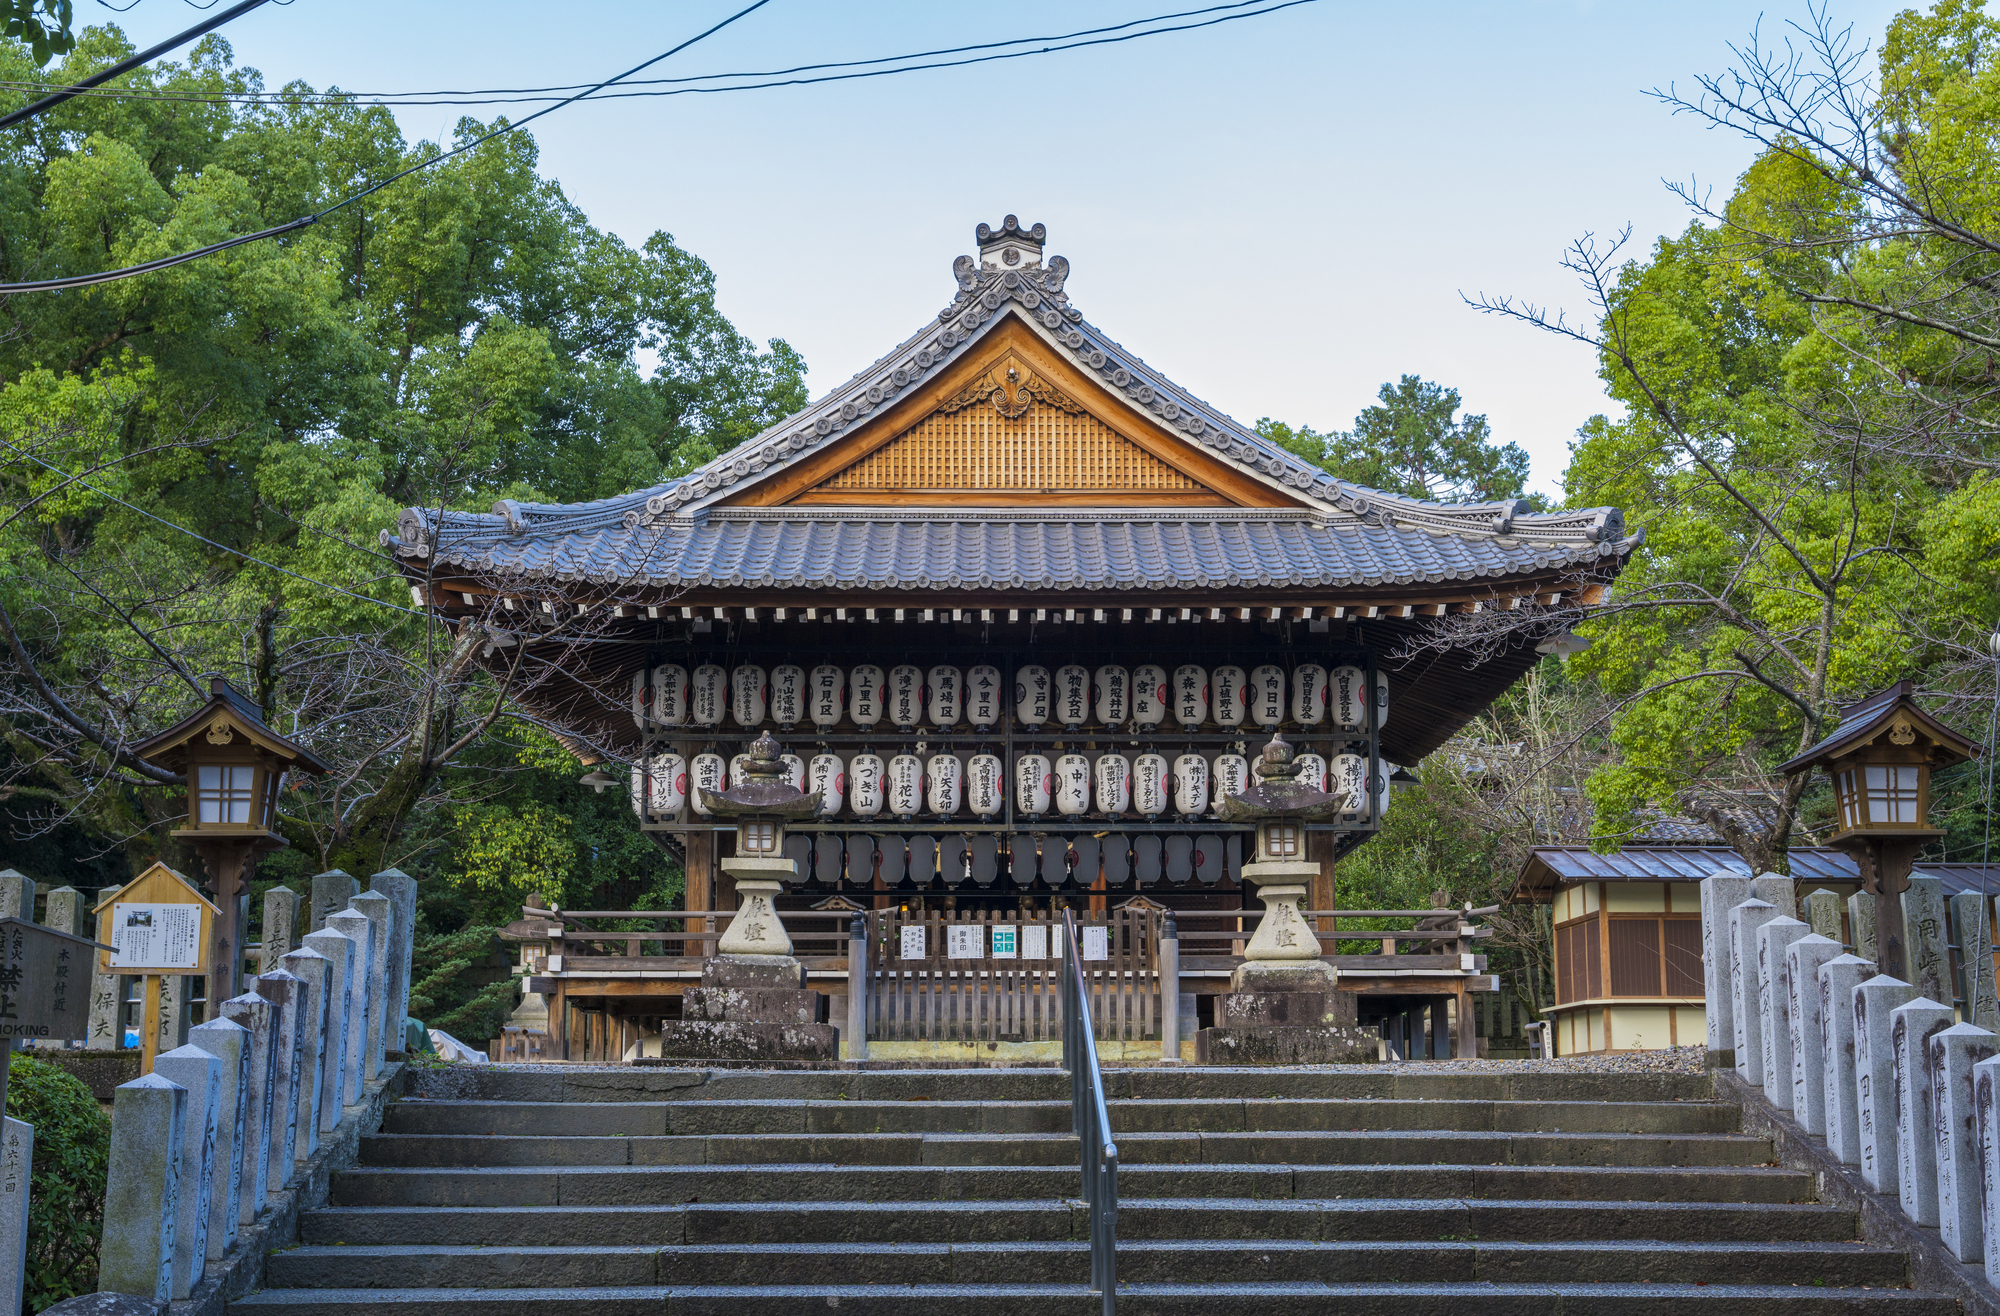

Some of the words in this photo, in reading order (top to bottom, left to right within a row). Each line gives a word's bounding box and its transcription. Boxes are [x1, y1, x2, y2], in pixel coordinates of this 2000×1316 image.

[819, 675, 834, 716] 石見区
[858, 676, 873, 716] 上里区
[940, 677, 954, 718] 馬場区
[977, 676, 993, 718] 今里区
[1034, 675, 1047, 717] 寺戸区
[1067, 675, 1083, 718] 物集女区
[1109, 675, 1122, 719] 鶏冠井区
[1136, 680, 1149, 713] 宮座
[1182, 676, 1197, 718] 森本区
[1219, 676, 1233, 720] 上植野区
[1265, 676, 1278, 718] 向日区
[1300, 673, 1315, 720] 西向日自治会
[860, 768, 873, 807] つき山
[898, 785, 913, 809] 花久
[939, 777, 953, 810] 矢尾卯
[980, 764, 992, 808] 高橋写真館
[1071, 768, 1083, 799] 中々
[11, 927, 23, 960] たき火
[959, 930, 967, 951] 御朱印
[53, 948, 71, 1011] 本殿付近
[0, 1024, 49, 1036] OKING
